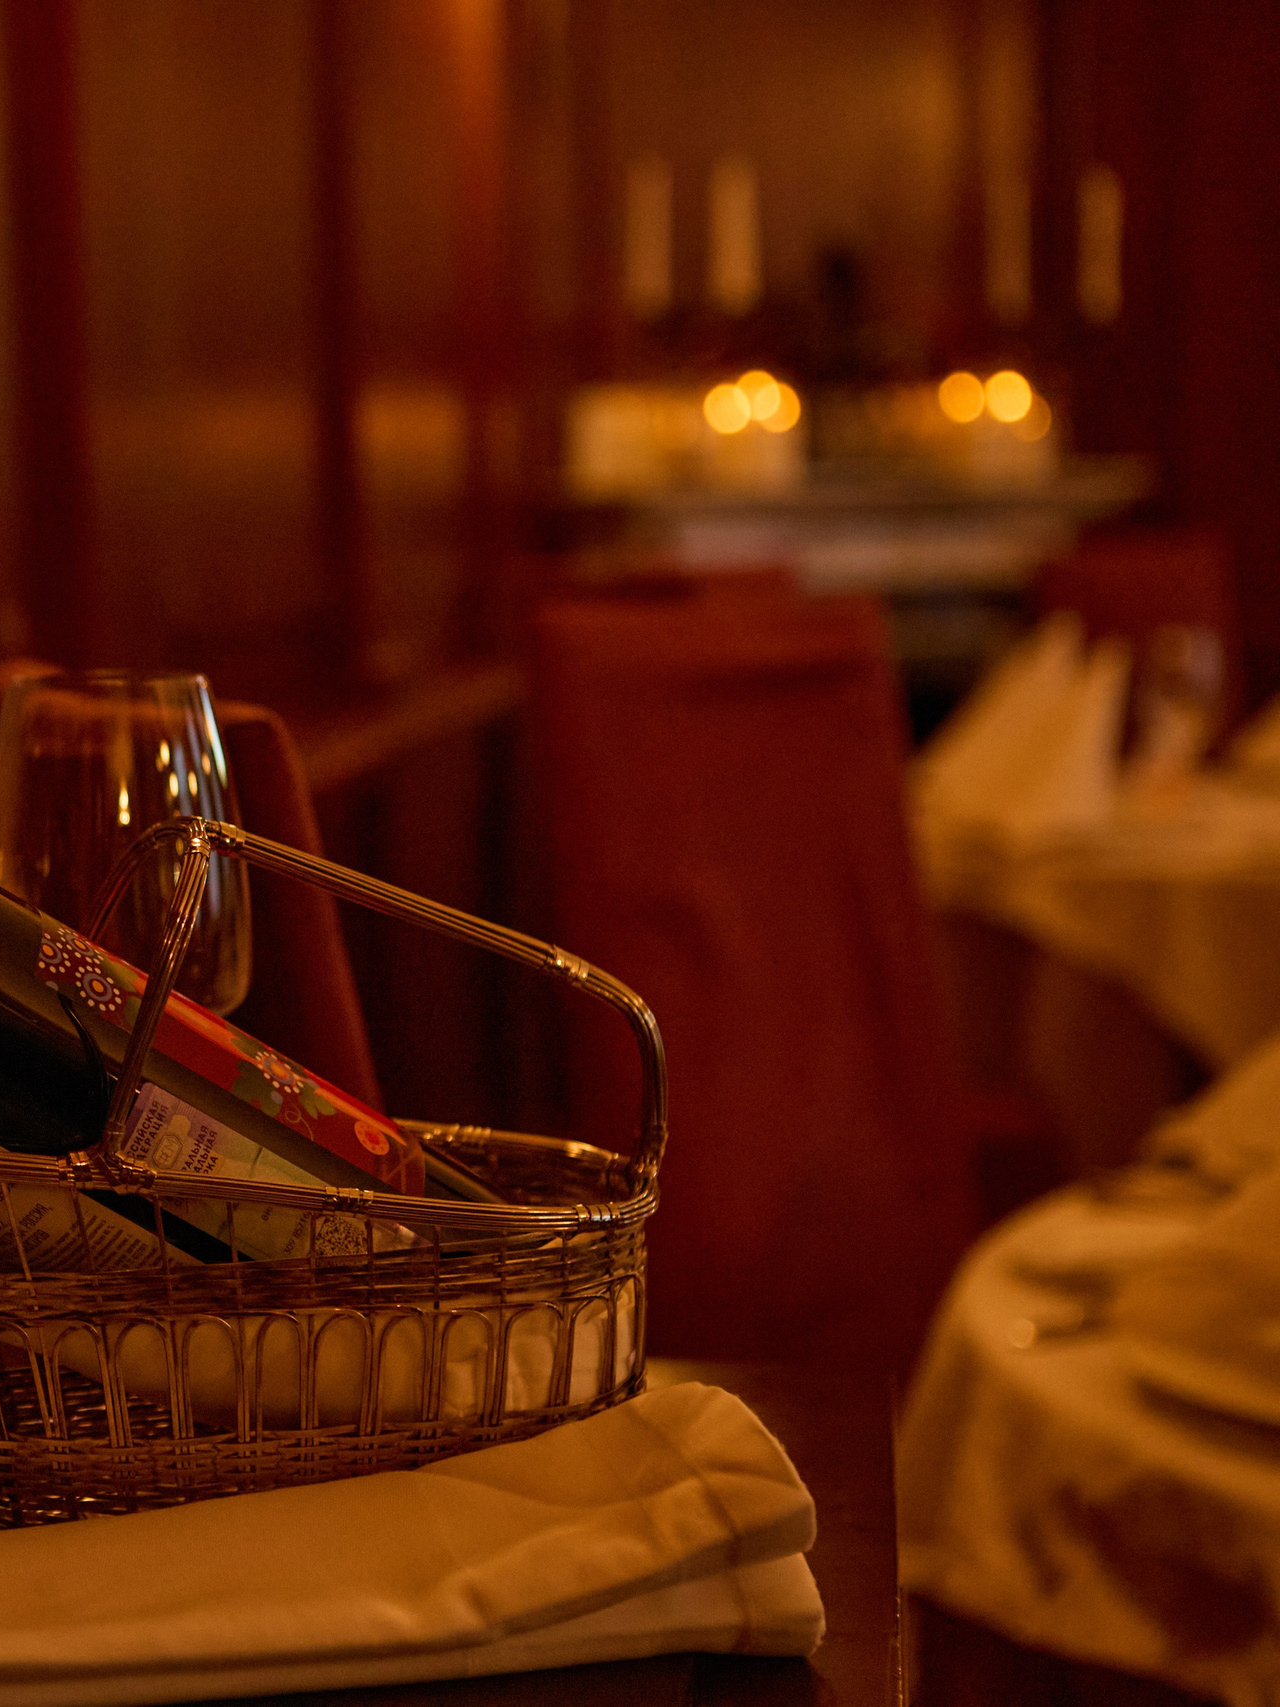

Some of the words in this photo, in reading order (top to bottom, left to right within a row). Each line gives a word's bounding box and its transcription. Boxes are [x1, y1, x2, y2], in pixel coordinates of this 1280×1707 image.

[126, 1100, 160, 1157] ССИЙСКАЯ
[135, 1105, 169, 1161] ДЕРАЦИЯ
[181, 1125, 209, 1172] АЛЬНАЯ
[194, 1130, 218, 1173] АЛЬНАЯ
